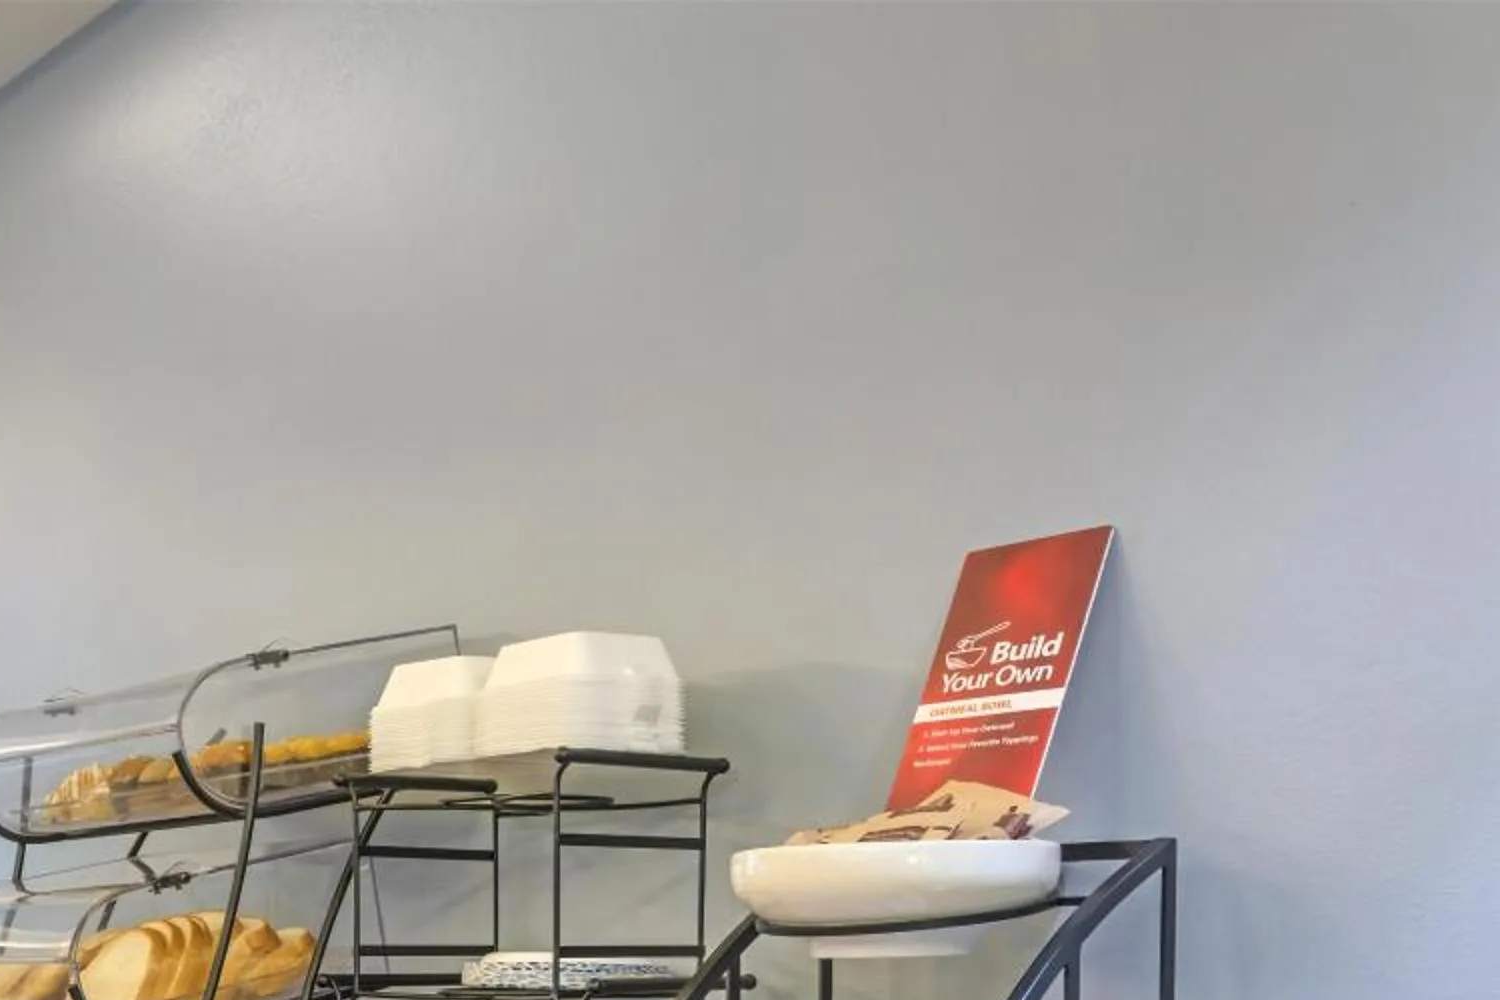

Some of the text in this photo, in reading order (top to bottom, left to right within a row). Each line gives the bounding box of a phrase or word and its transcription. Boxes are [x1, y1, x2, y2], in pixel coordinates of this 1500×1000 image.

[990, 631, 1064, 665] Build
[942, 664, 1053, 695] Your Own
